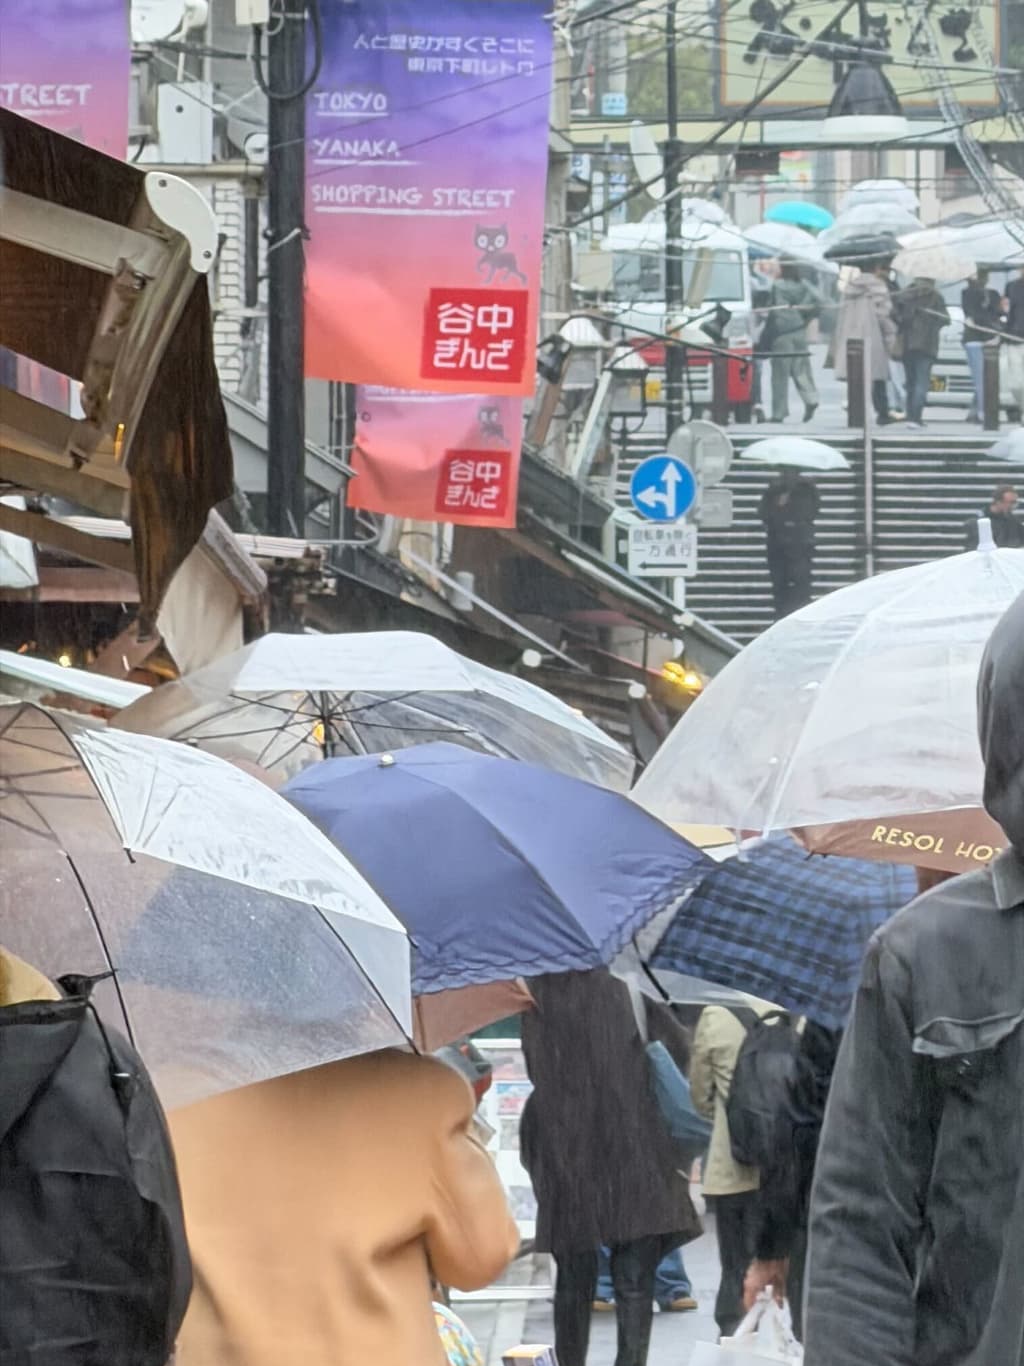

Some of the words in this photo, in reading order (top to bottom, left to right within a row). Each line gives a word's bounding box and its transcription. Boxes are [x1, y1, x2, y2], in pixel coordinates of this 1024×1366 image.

[313, 92, 388, 111] TOKYO
[313, 138, 400, 157] YANAKA
[312, 183, 423, 205] SHOPPING
[432, 187, 516, 208] STREET
[437, 303, 514, 335] 谷中
[433, 337, 515, 370] ぎんざ
[450, 460, 502, 483] 谷中
[444, 485, 500, 509] ぎんざ
[871, 825, 945, 854] RESOL
